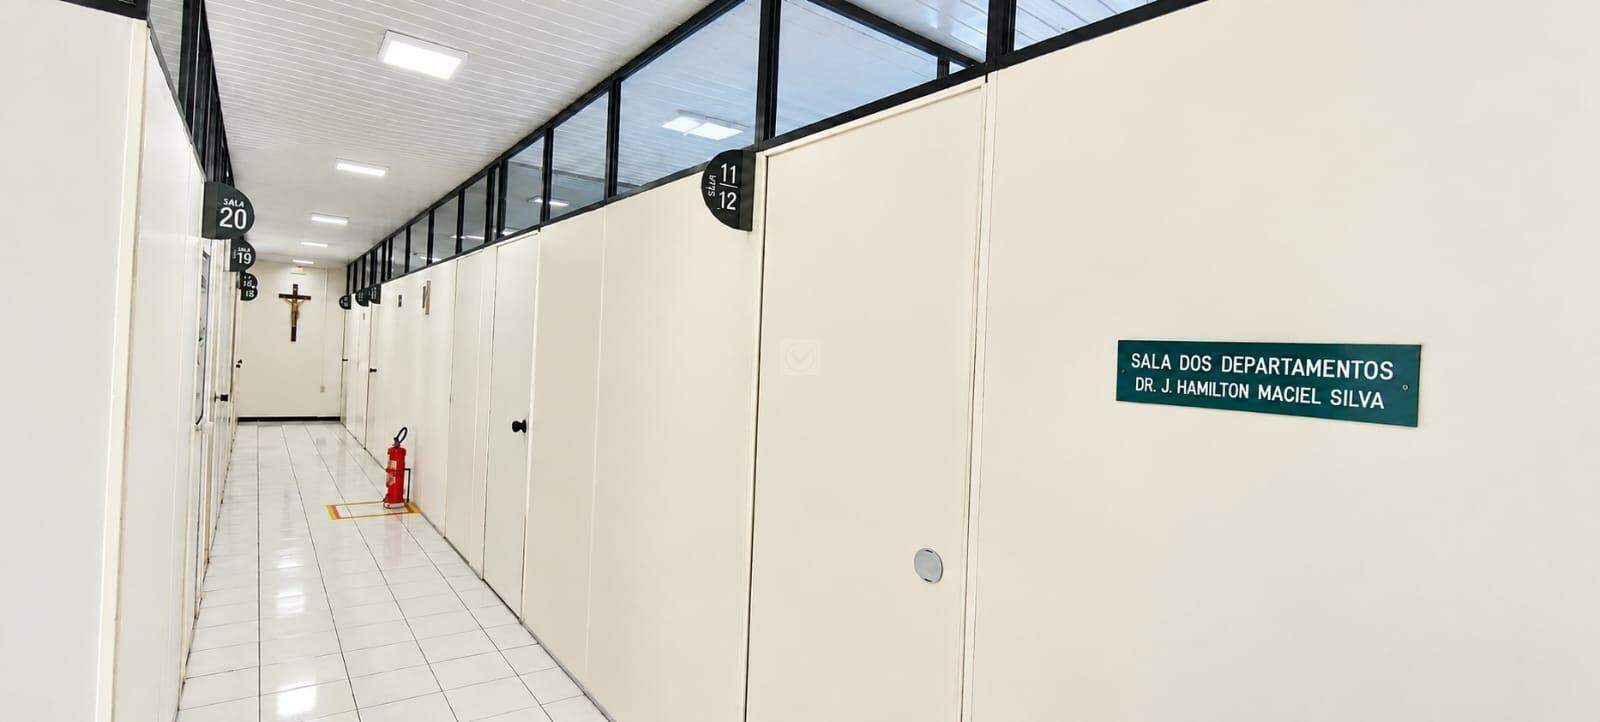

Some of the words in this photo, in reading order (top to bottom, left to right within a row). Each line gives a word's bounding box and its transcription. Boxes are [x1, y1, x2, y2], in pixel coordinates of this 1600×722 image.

[720, 162, 737, 184] 11
[223, 198, 245, 208] SALA
[719, 191, 737, 211] 12
[219, 207, 247, 229] 20
[237, 252, 252, 264] 19
[1131, 353, 1172, 370] SALA
[1179, 355, 1212, 372] DOS
[1221, 356, 1394, 380] DEPARTAMENTOS
[1135, 376, 1156, 393] DR.
[1161, 378, 1172, 394] J.
[1177, 380, 1249, 399] HAMILTON
[1258, 385, 1321, 404] MACIEL
[1330, 389, 1385, 409] SILVA
